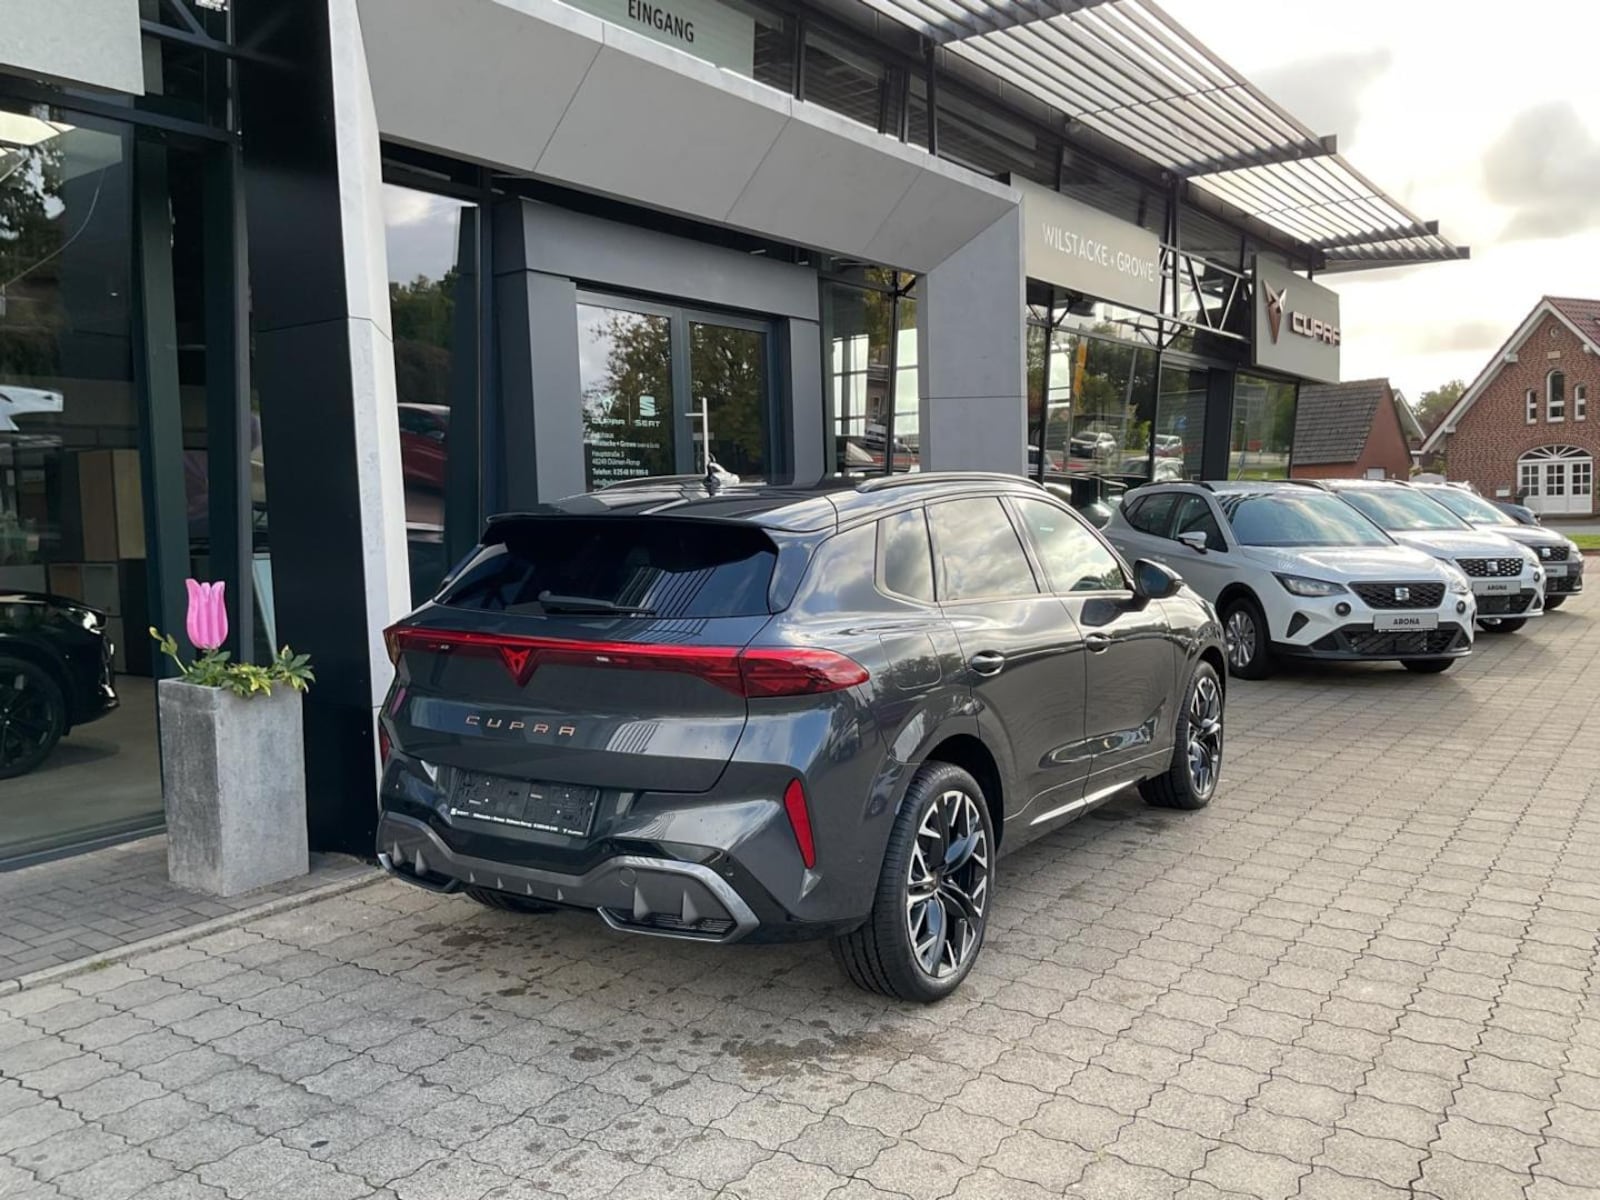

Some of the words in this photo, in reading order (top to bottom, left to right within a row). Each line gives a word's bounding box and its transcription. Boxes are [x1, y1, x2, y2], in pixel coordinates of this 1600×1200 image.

[628, 0, 694, 42] EINGANG
[1042, 223, 1108, 266] WILSTACKE
[1116, 251, 1154, 282] GROWE
[1393, 617, 1420, 625] ARONA
[465, 715, 576, 736] CUPRA
